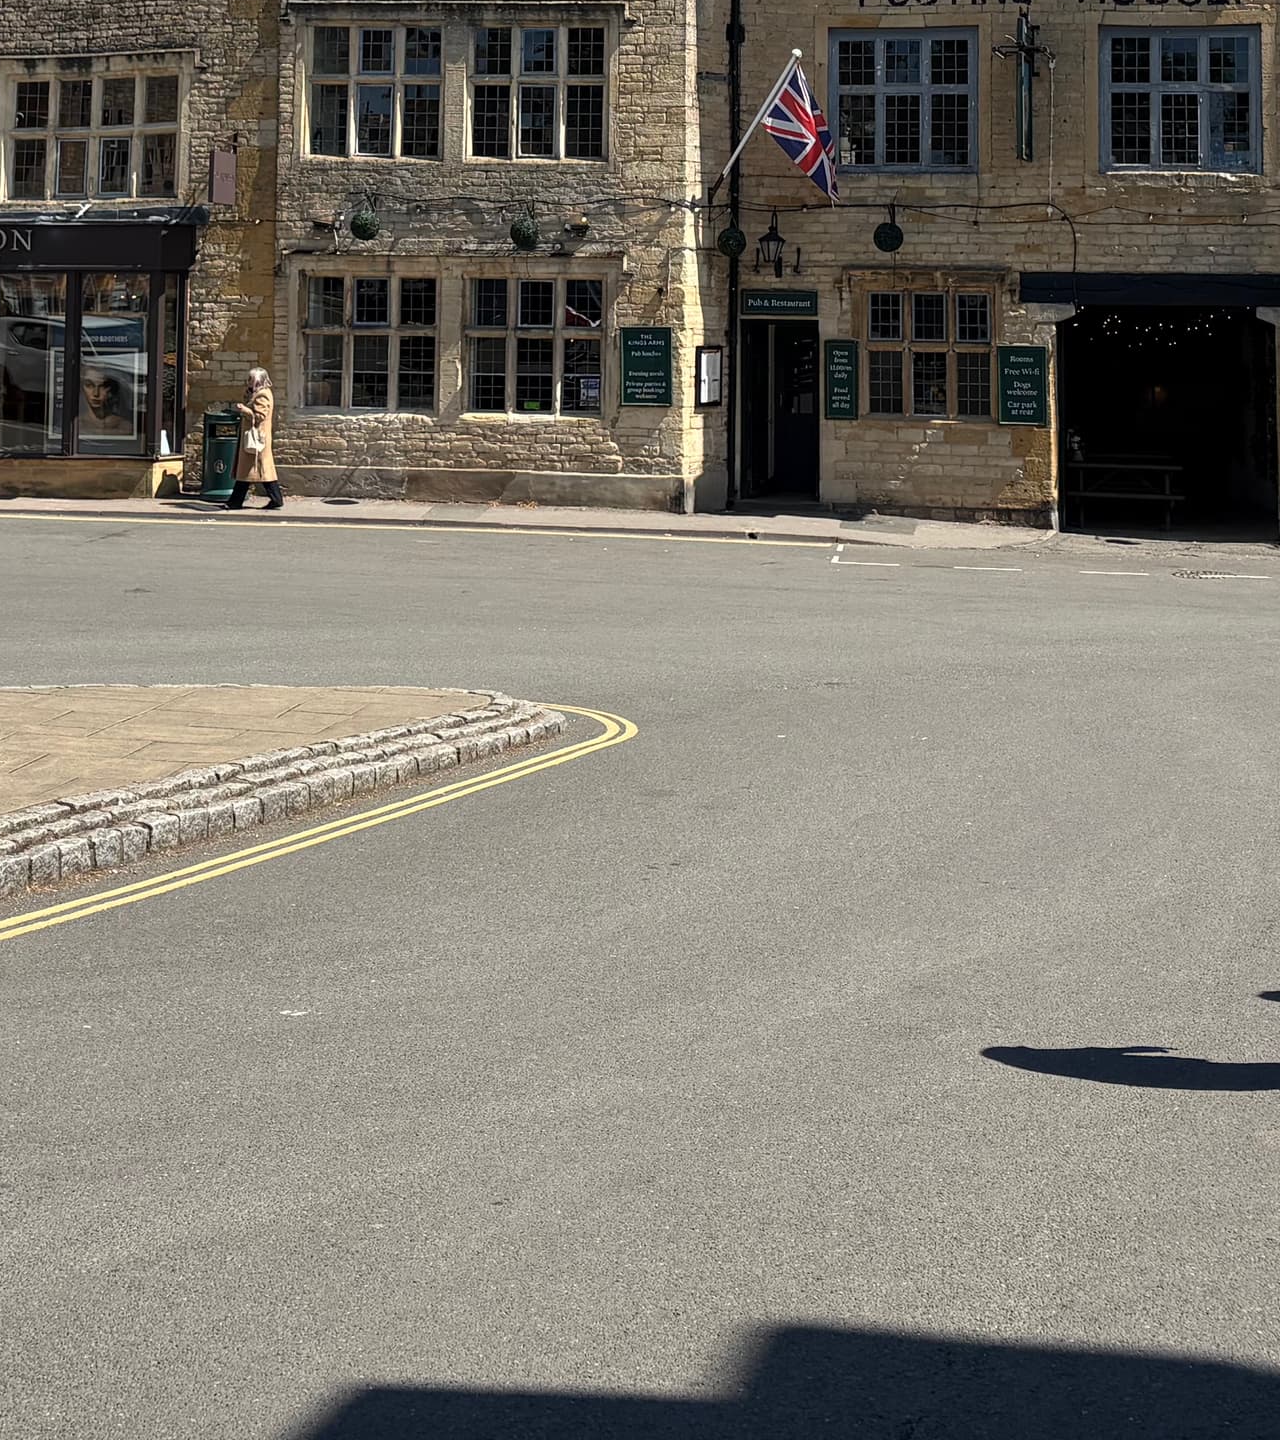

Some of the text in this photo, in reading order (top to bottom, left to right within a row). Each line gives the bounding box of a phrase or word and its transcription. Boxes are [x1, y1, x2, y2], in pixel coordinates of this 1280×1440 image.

[748, 299, 762, 307] Pub
[763, 299, 770, 307] &
[1013, 381, 1031, 389] Dogs
[1021, 401, 1037, 409] park
